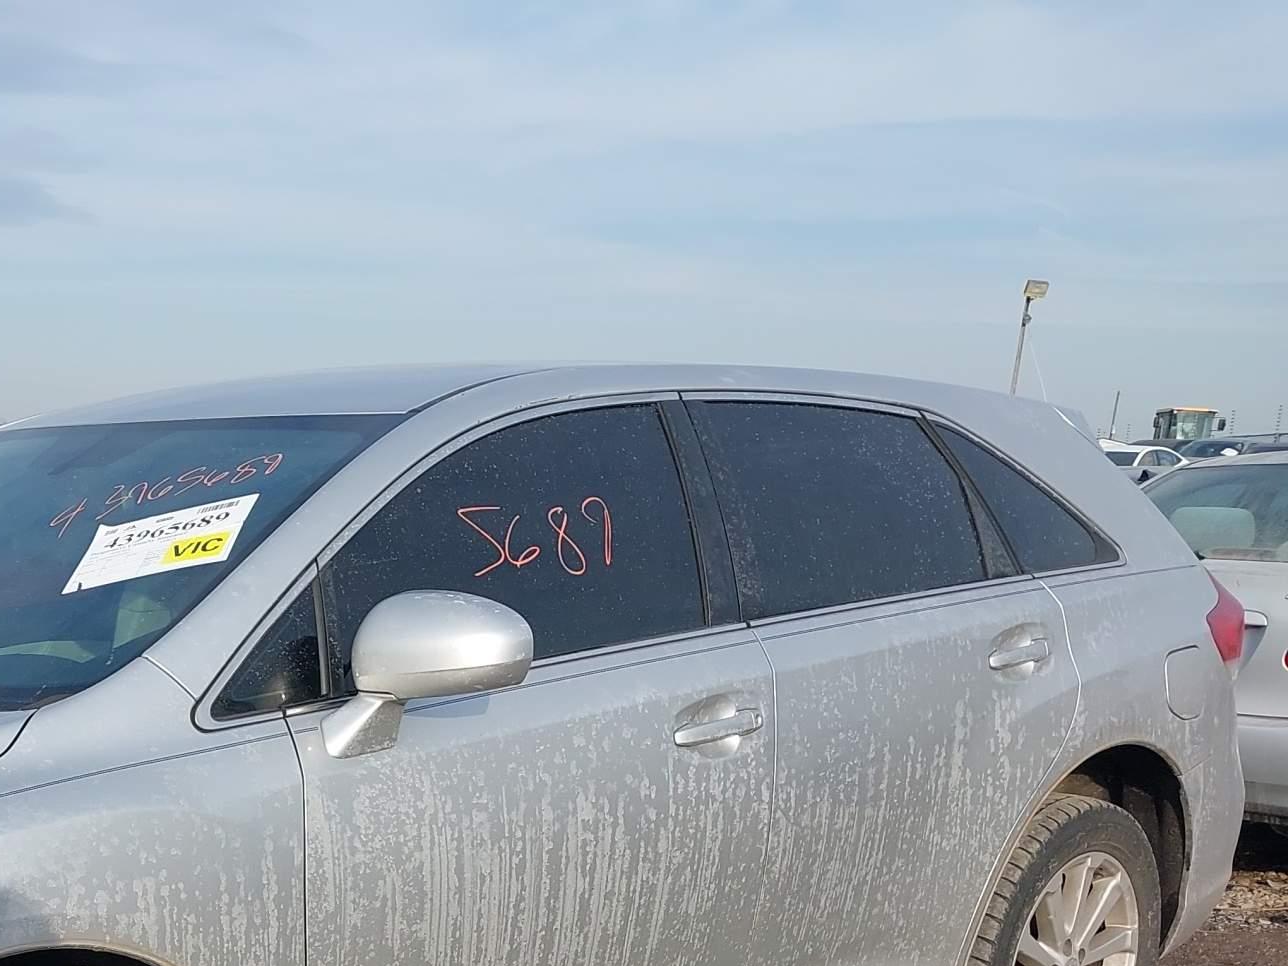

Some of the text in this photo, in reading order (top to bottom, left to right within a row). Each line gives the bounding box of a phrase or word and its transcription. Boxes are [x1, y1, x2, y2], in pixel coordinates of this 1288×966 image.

[103, 511, 231, 549] 43965689
[173, 537, 224, 558] VIC
[457, 496, 612, 576] 5689
